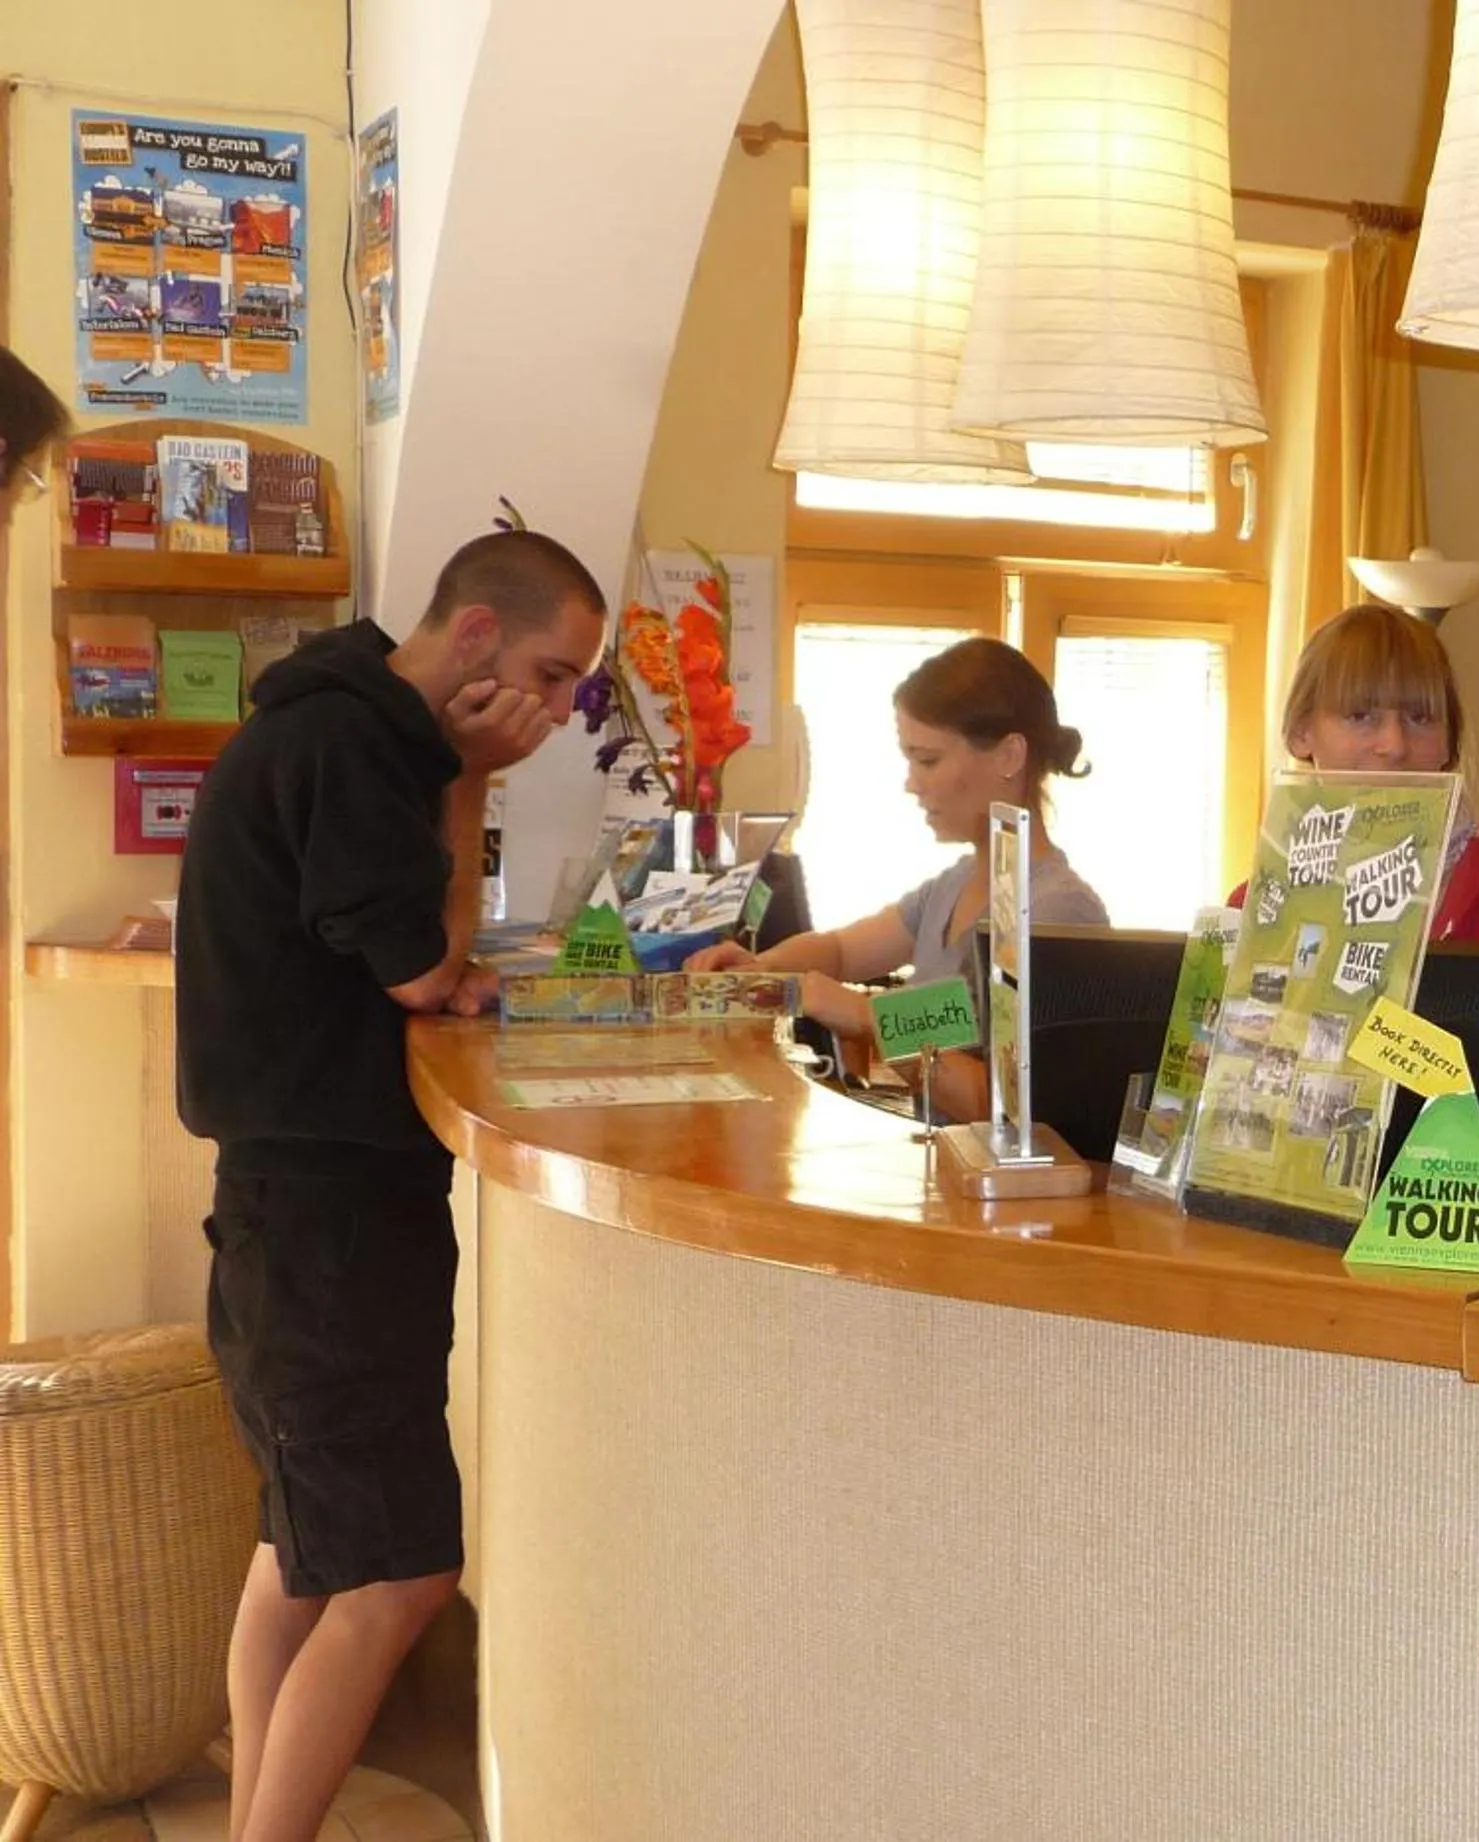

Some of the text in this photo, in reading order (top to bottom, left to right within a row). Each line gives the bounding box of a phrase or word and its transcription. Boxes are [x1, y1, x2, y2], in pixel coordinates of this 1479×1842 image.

[134, 128, 260, 153] Are you gonna
[186, 154, 208, 169] go
[213, 157, 240, 172] my
[167, 440, 242, 460] BAD GASTEIN
[1297, 812, 1346, 846] WINE
[1289, 862, 1338, 889] TOUR
[1346, 842, 1417, 896] WALKING
[1346, 866, 1418, 927] TOUR
[586, 942, 623, 959] BIKE
[1346, 942, 1384, 969] BIKE
[1340, 967, 1380, 986] RENTAL
[880, 999, 973, 1041] Elisabeth
[1368, 1015, 1463, 1080] BOOK DIRECTLY
